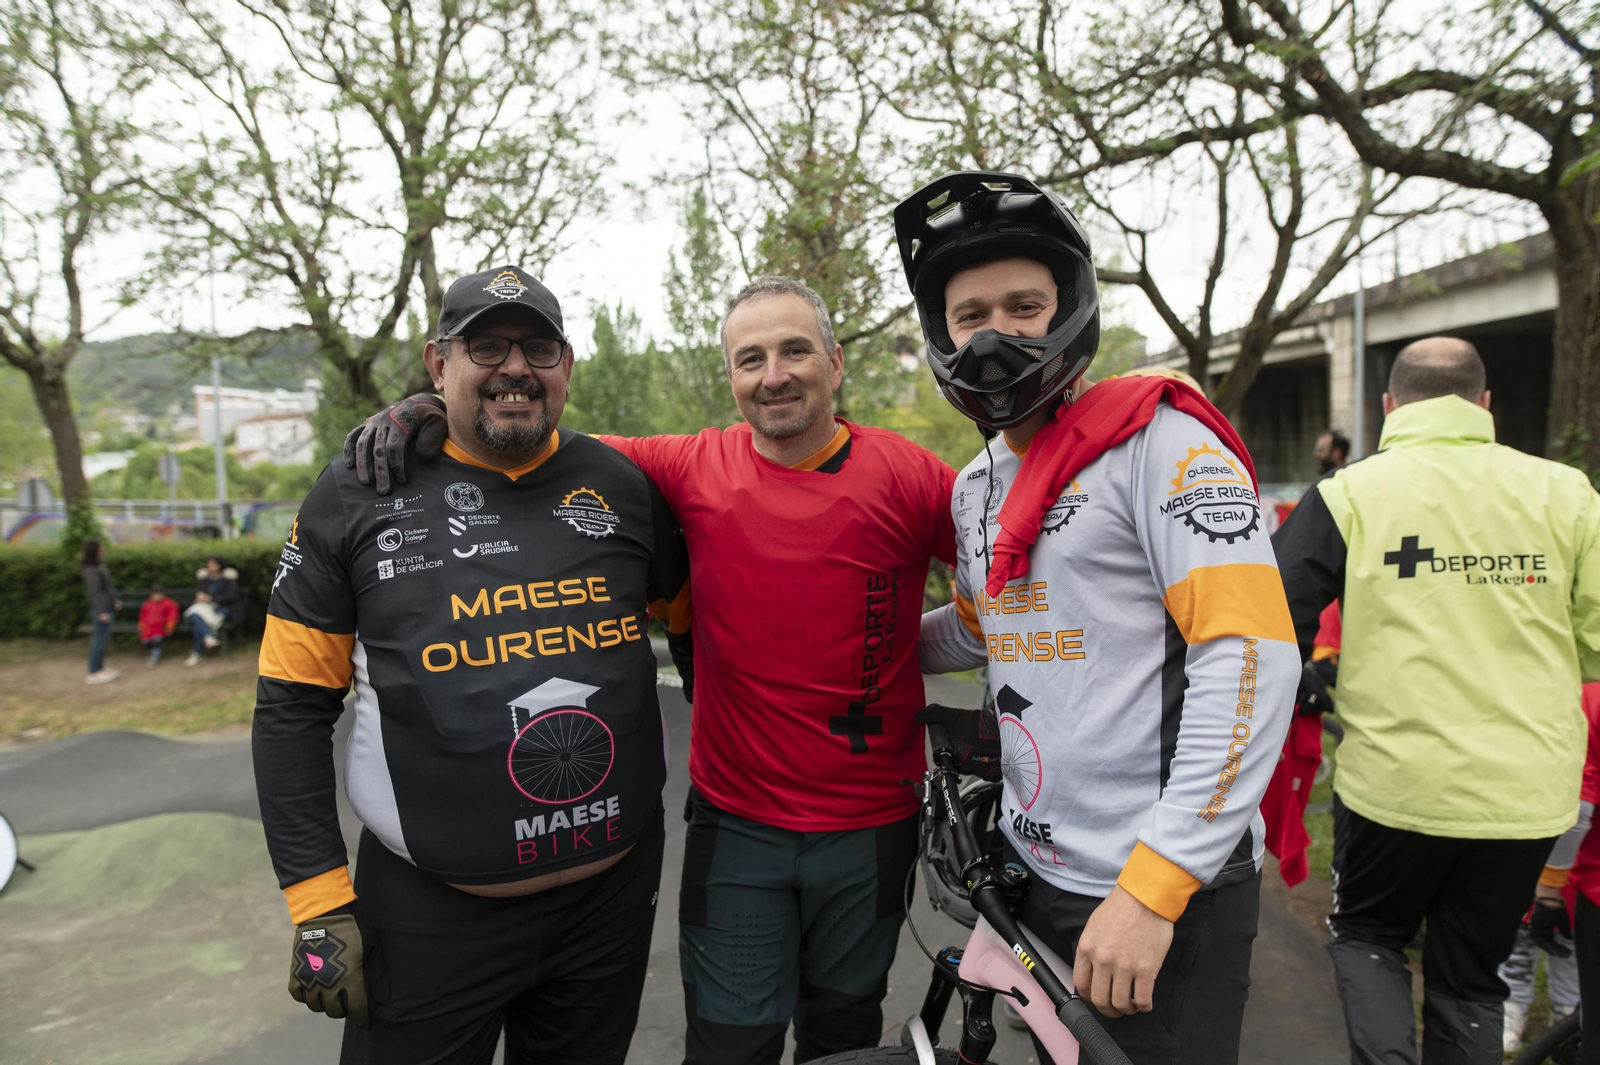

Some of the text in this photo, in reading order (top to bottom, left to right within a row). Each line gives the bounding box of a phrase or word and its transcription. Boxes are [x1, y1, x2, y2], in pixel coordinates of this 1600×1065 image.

[572, 497, 601, 506] OURENSE
[1160, 486, 1259, 516] MAESE RIDER
[552, 509, 621, 524] MAESE RIDERS
[1045, 512, 1063, 522] EAM
[1202, 510, 1247, 524] TEAM
[404, 528, 429, 536] Ciclismo
[404, 534, 427, 542] Galego
[479, 540, 510, 549] GALICIA
[479, 545, 519, 556] SAUDABLE
[395, 555, 425, 566] XUNTA
[396, 559, 444, 574] DE GALICIA
[1465, 573, 1488, 585] La
[450, 576, 612, 620] MAESE
[421, 615, 642, 673] OURENSE
[983, 629, 1086, 662] RENSE
[1196, 638, 1260, 824] MAESE OURENSE
[514, 795, 621, 841] MAESE
[516, 816, 622, 865] BIKE
